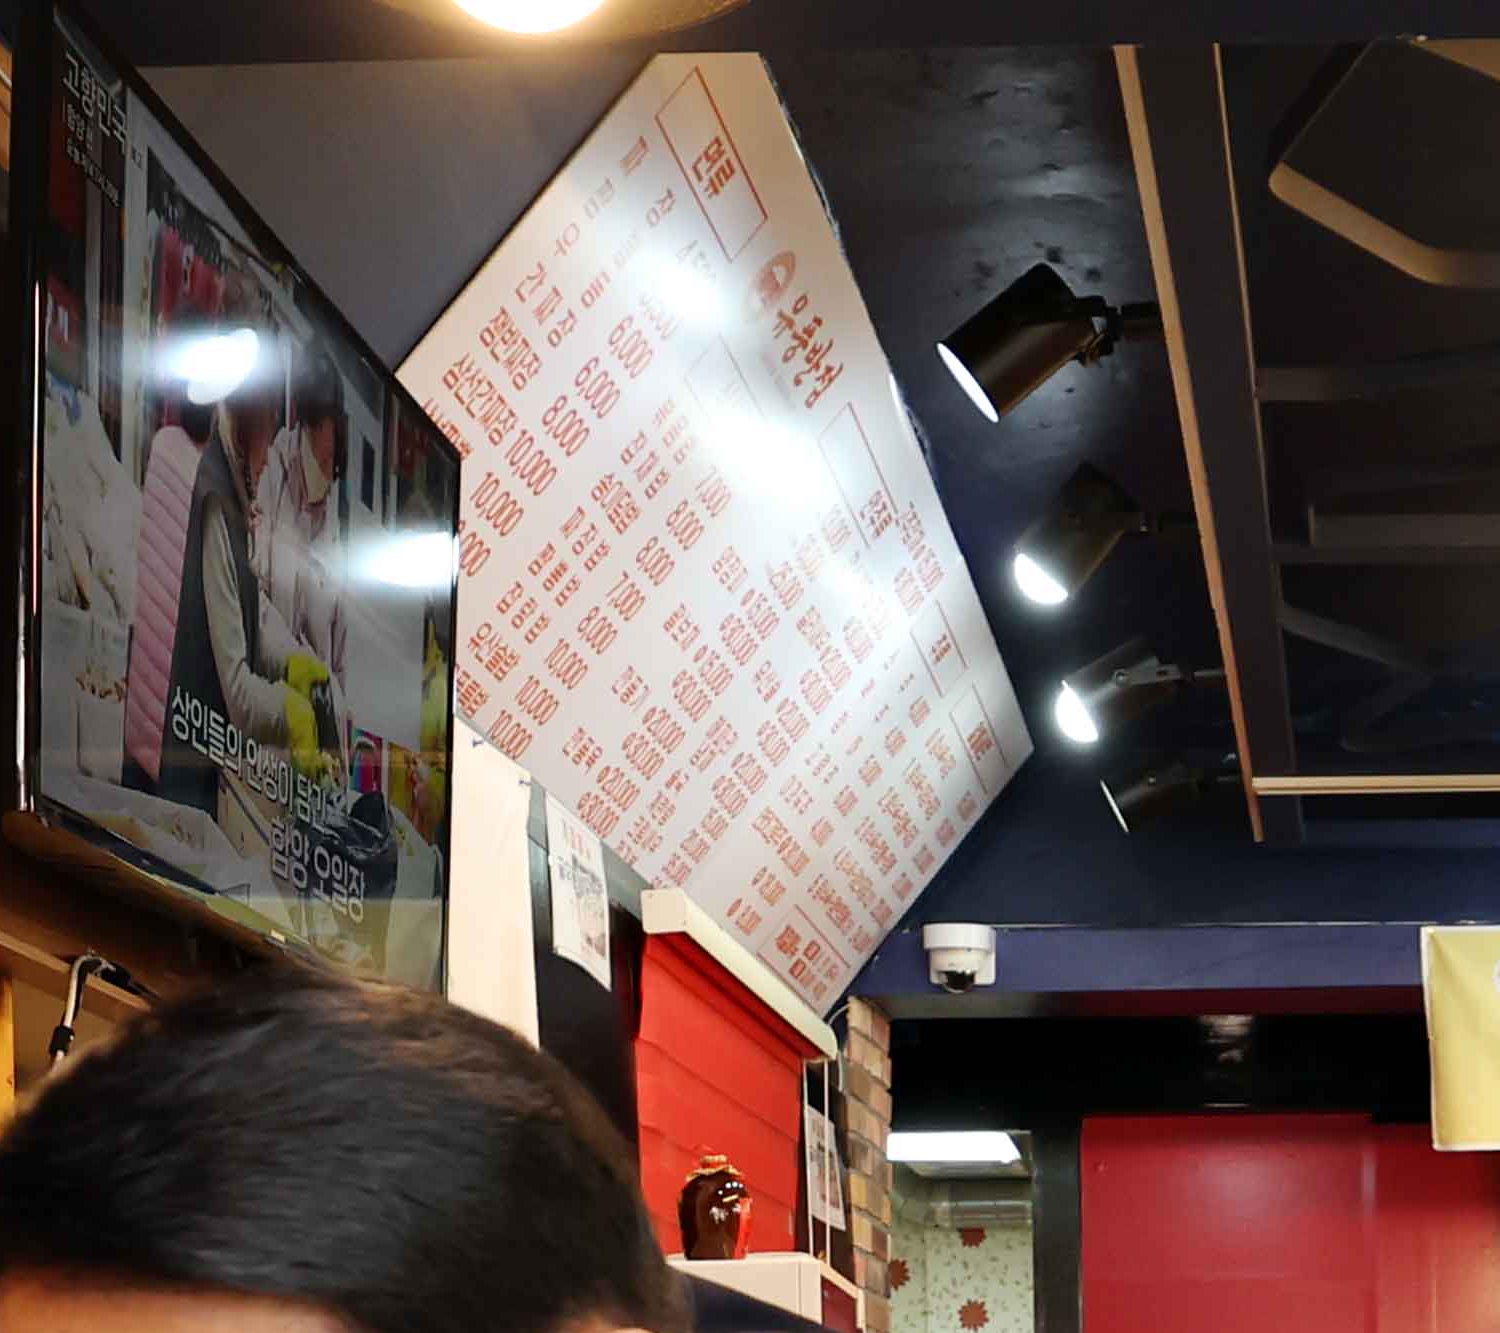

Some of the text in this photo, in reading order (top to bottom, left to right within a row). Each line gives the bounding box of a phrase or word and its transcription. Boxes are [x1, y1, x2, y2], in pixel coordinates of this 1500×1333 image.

[692, 135, 734, 203] 면류
[768, 278, 845, 411] 유풍반점
[571, 355, 621, 421] 6,000
[539, 394, 590, 459] 8,000
[500, 428, 559, 500] 10,000
[172, 686, 242, 778] 상인들의
[246, 739, 293, 811] 인생이
[270, 816, 364, 924] 함양 오일장
